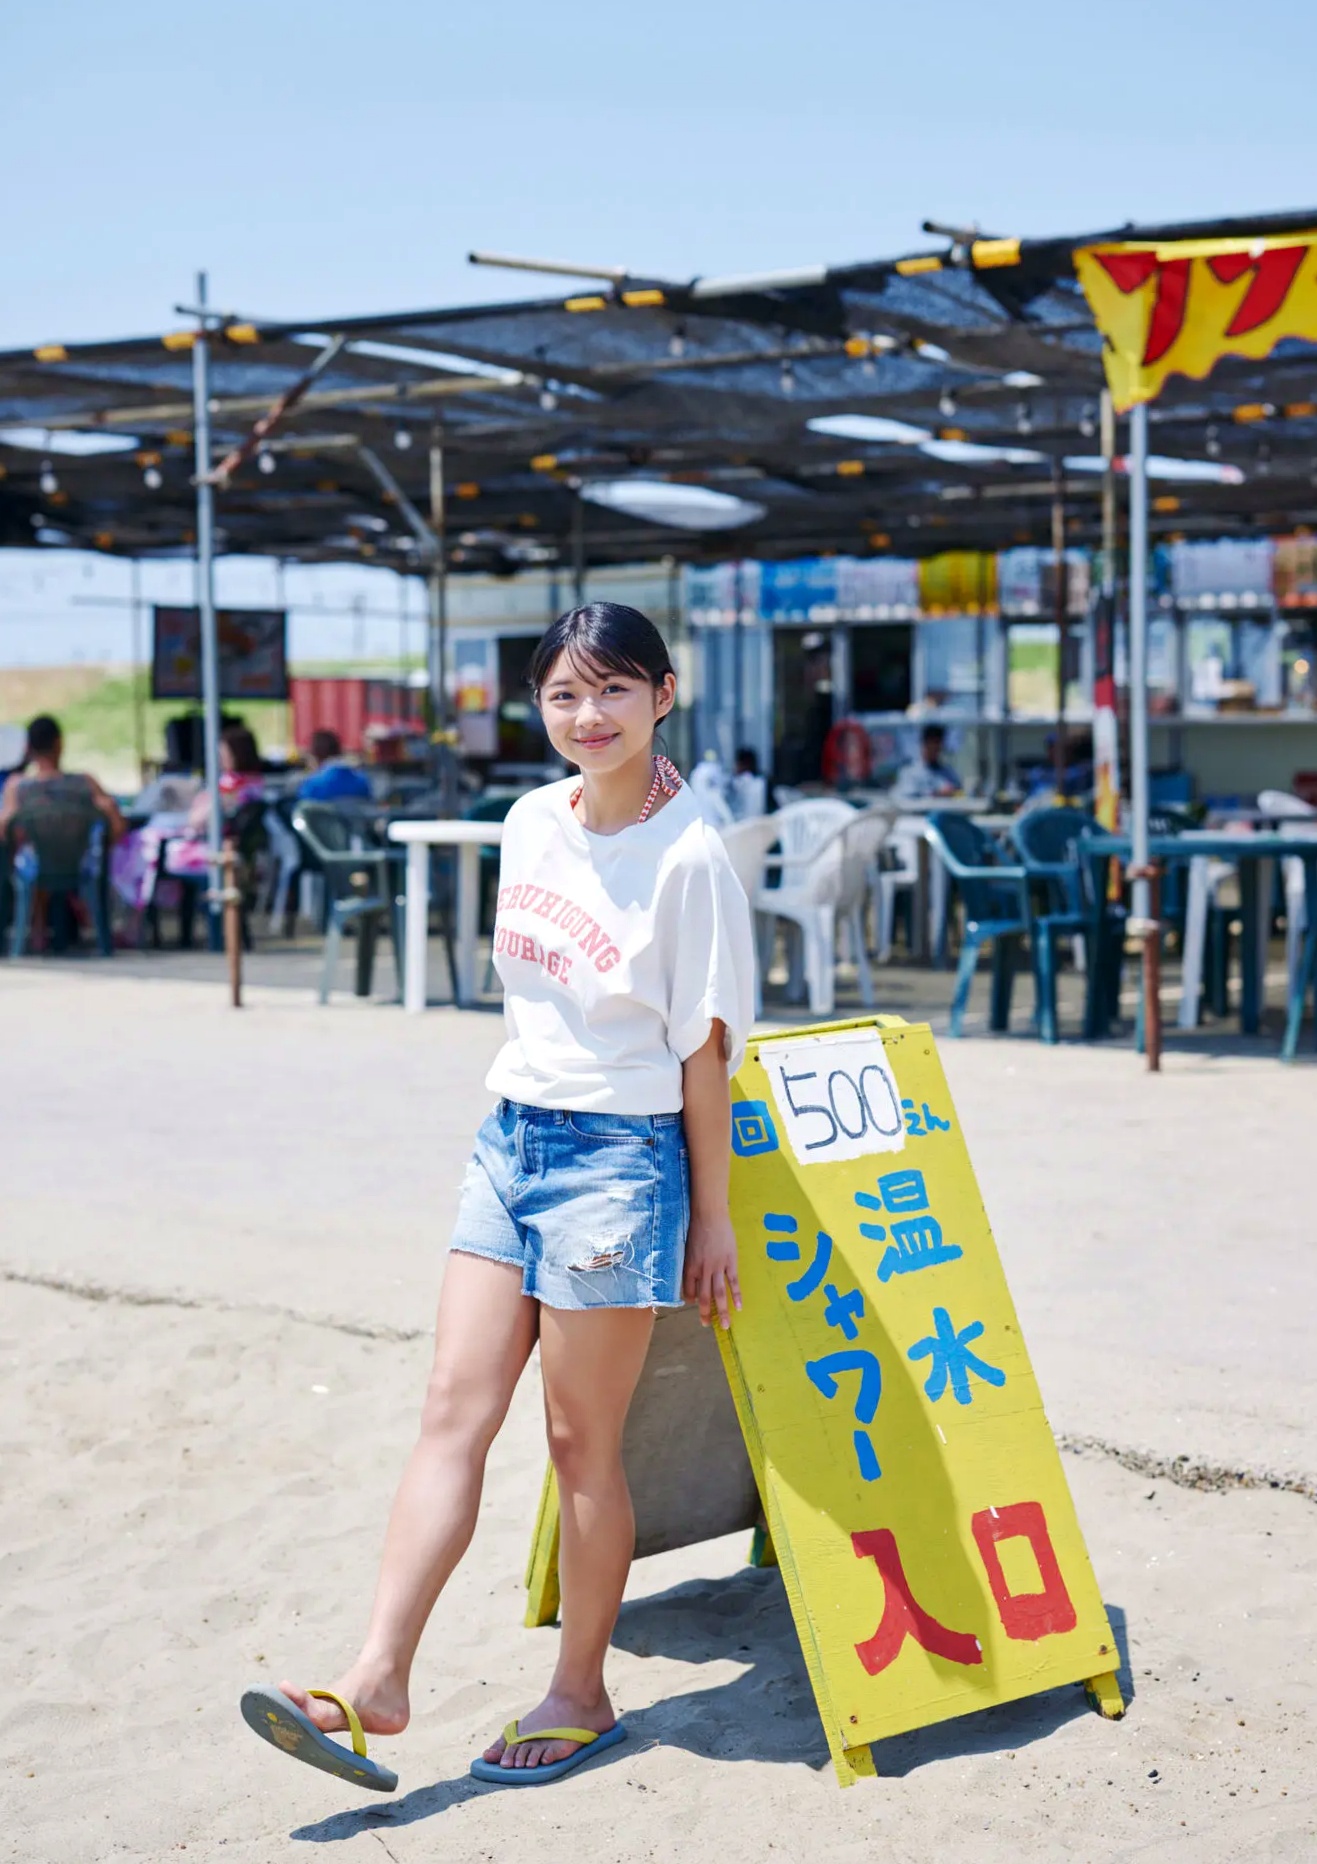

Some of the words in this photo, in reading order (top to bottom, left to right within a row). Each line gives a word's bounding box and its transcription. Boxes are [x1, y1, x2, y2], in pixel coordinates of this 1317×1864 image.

[496, 926, 573, 985] OURGE
[497, 884, 621, 974] ERUHIGUNG
[779, 1064, 902, 1150] 500
[763, 1212, 882, 1482] シャワー
[854, 1169, 1006, 1405] 温水
[851, 1501, 1077, 1676] 入口
